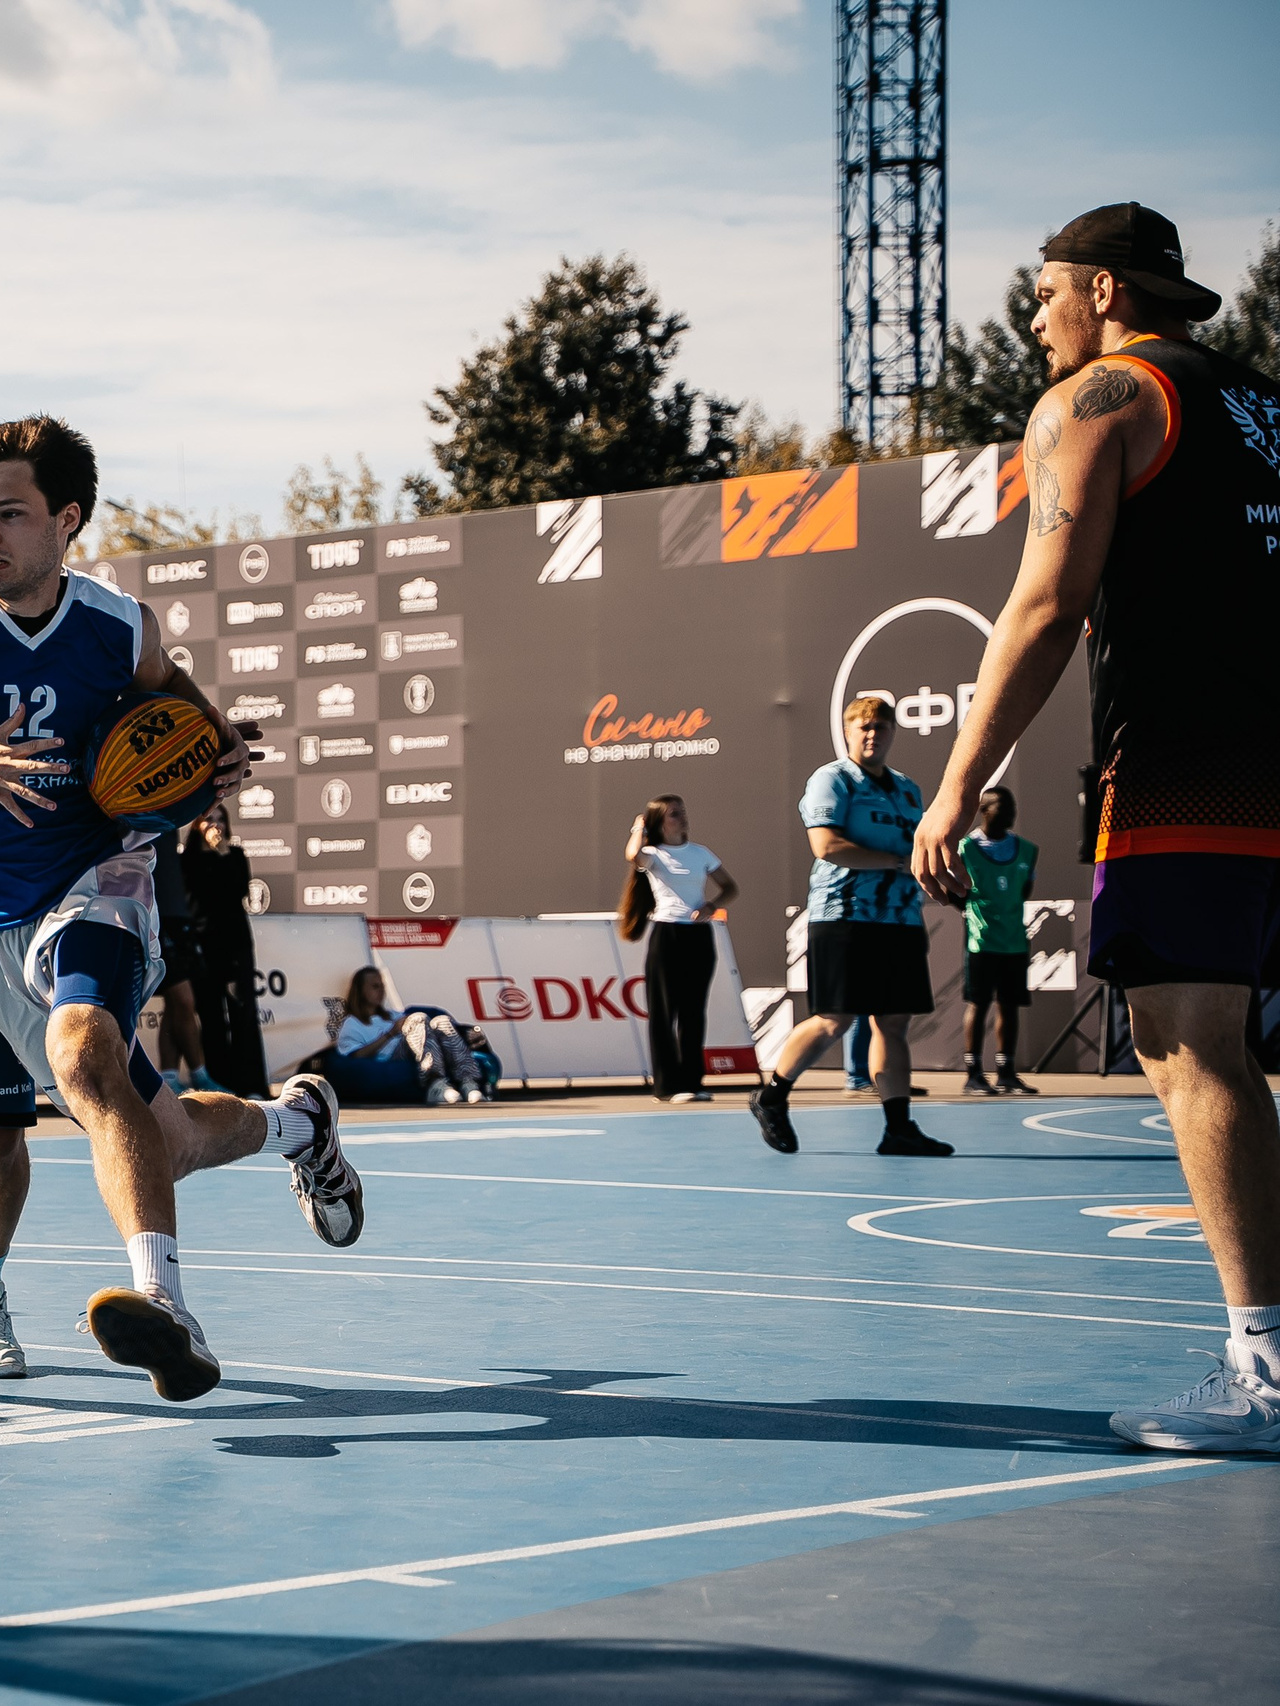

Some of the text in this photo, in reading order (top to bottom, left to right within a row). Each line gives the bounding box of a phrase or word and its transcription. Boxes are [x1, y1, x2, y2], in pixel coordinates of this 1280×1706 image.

[1246, 504, 1280, 524] МИ
[1266, 535, 1280, 554] Р
[3, 684, 57, 738] 12
[583, 693, 711, 747] Сильно
[564, 738, 720, 764] не значит громко
